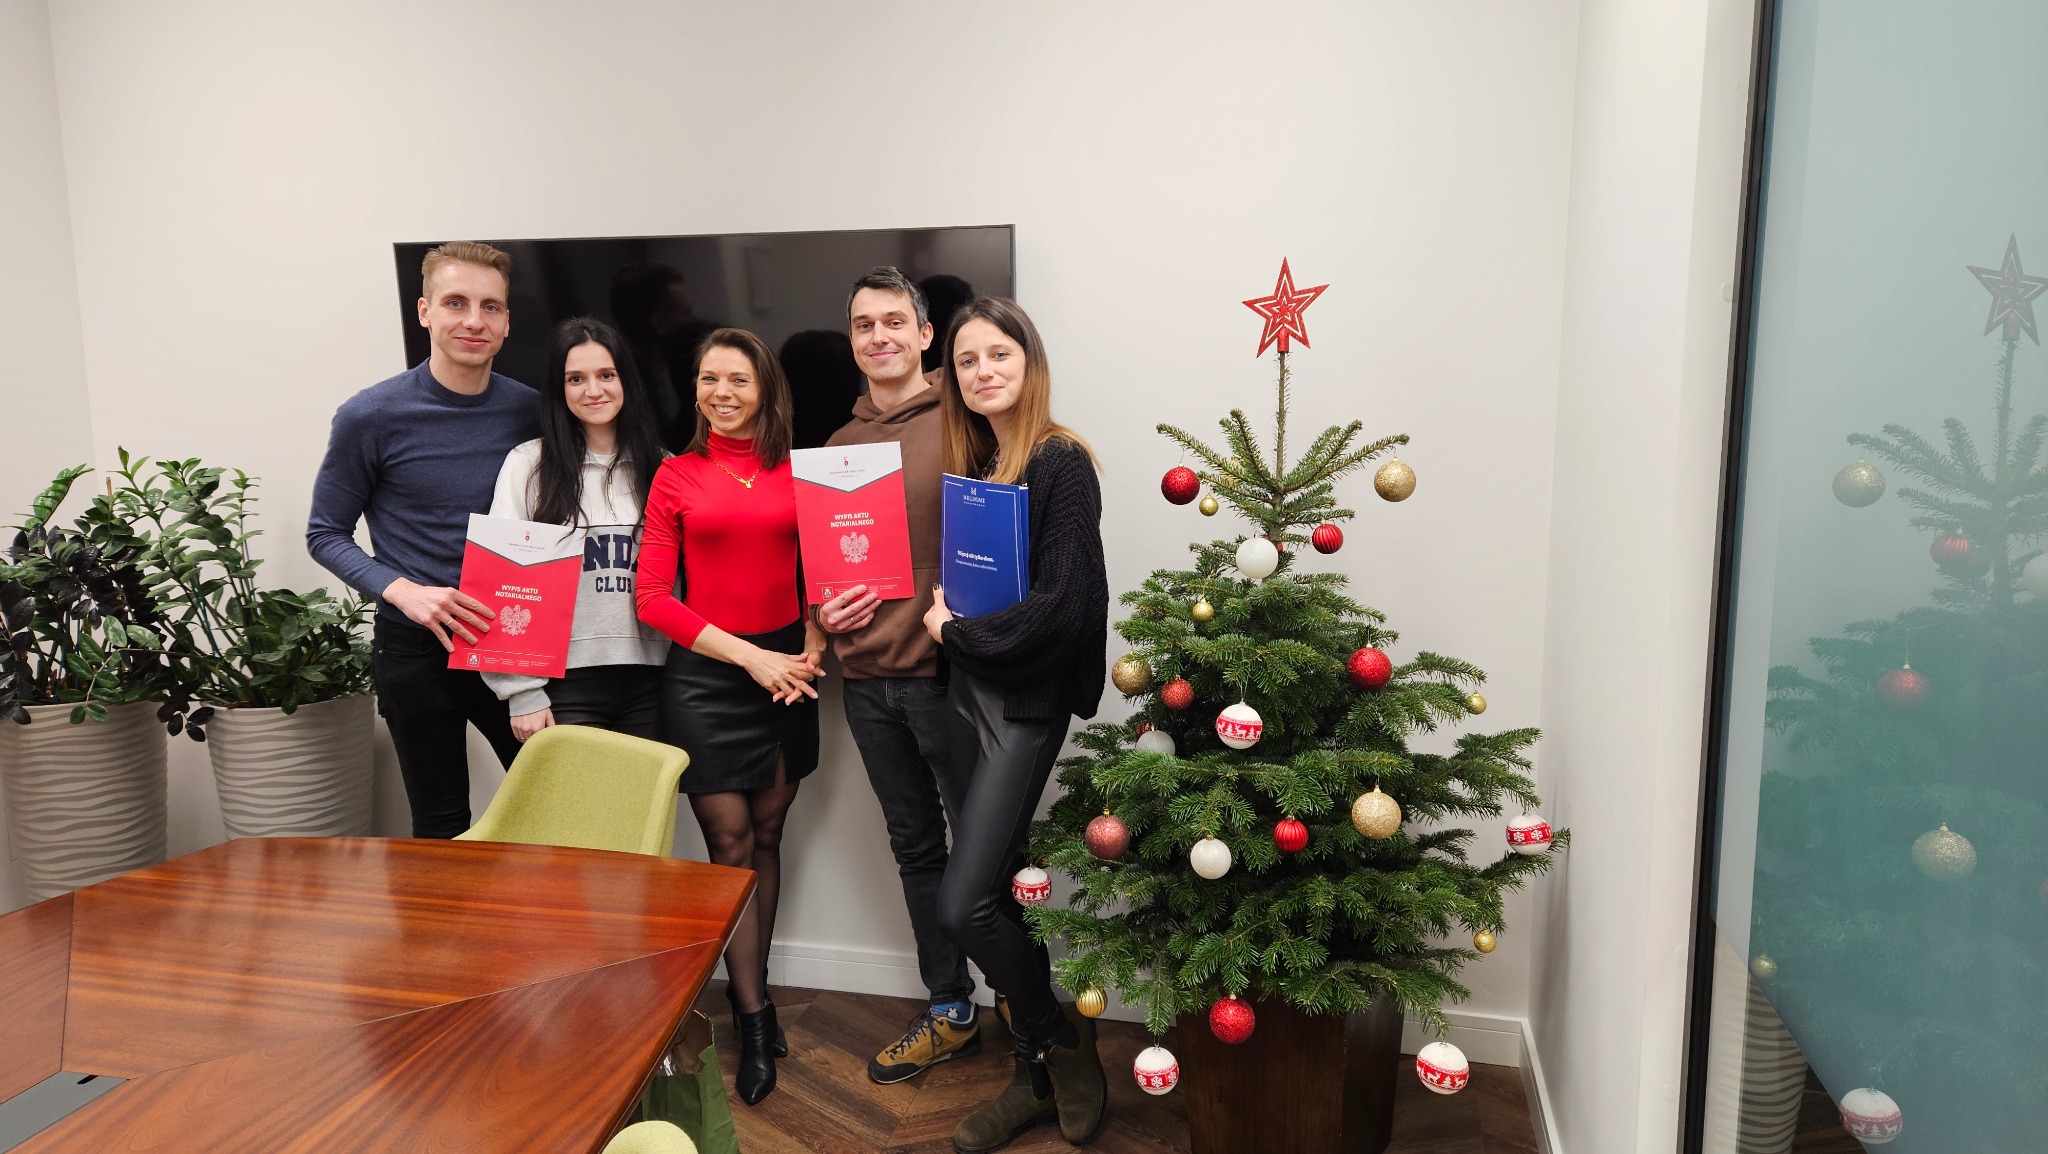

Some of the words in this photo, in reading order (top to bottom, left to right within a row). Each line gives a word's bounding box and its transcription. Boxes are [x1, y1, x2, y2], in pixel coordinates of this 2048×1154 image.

[854, 511, 869, 519] AKTU
[830, 519, 874, 528] NOTARIALNEGO
[583, 534, 639, 573] ND
[501, 584, 521, 592] WYPIS
[521, 587, 538, 595] AKTU
[595, 576, 632, 593] CLUB
[495, 591, 542, 602] NOTARIALNEGO
